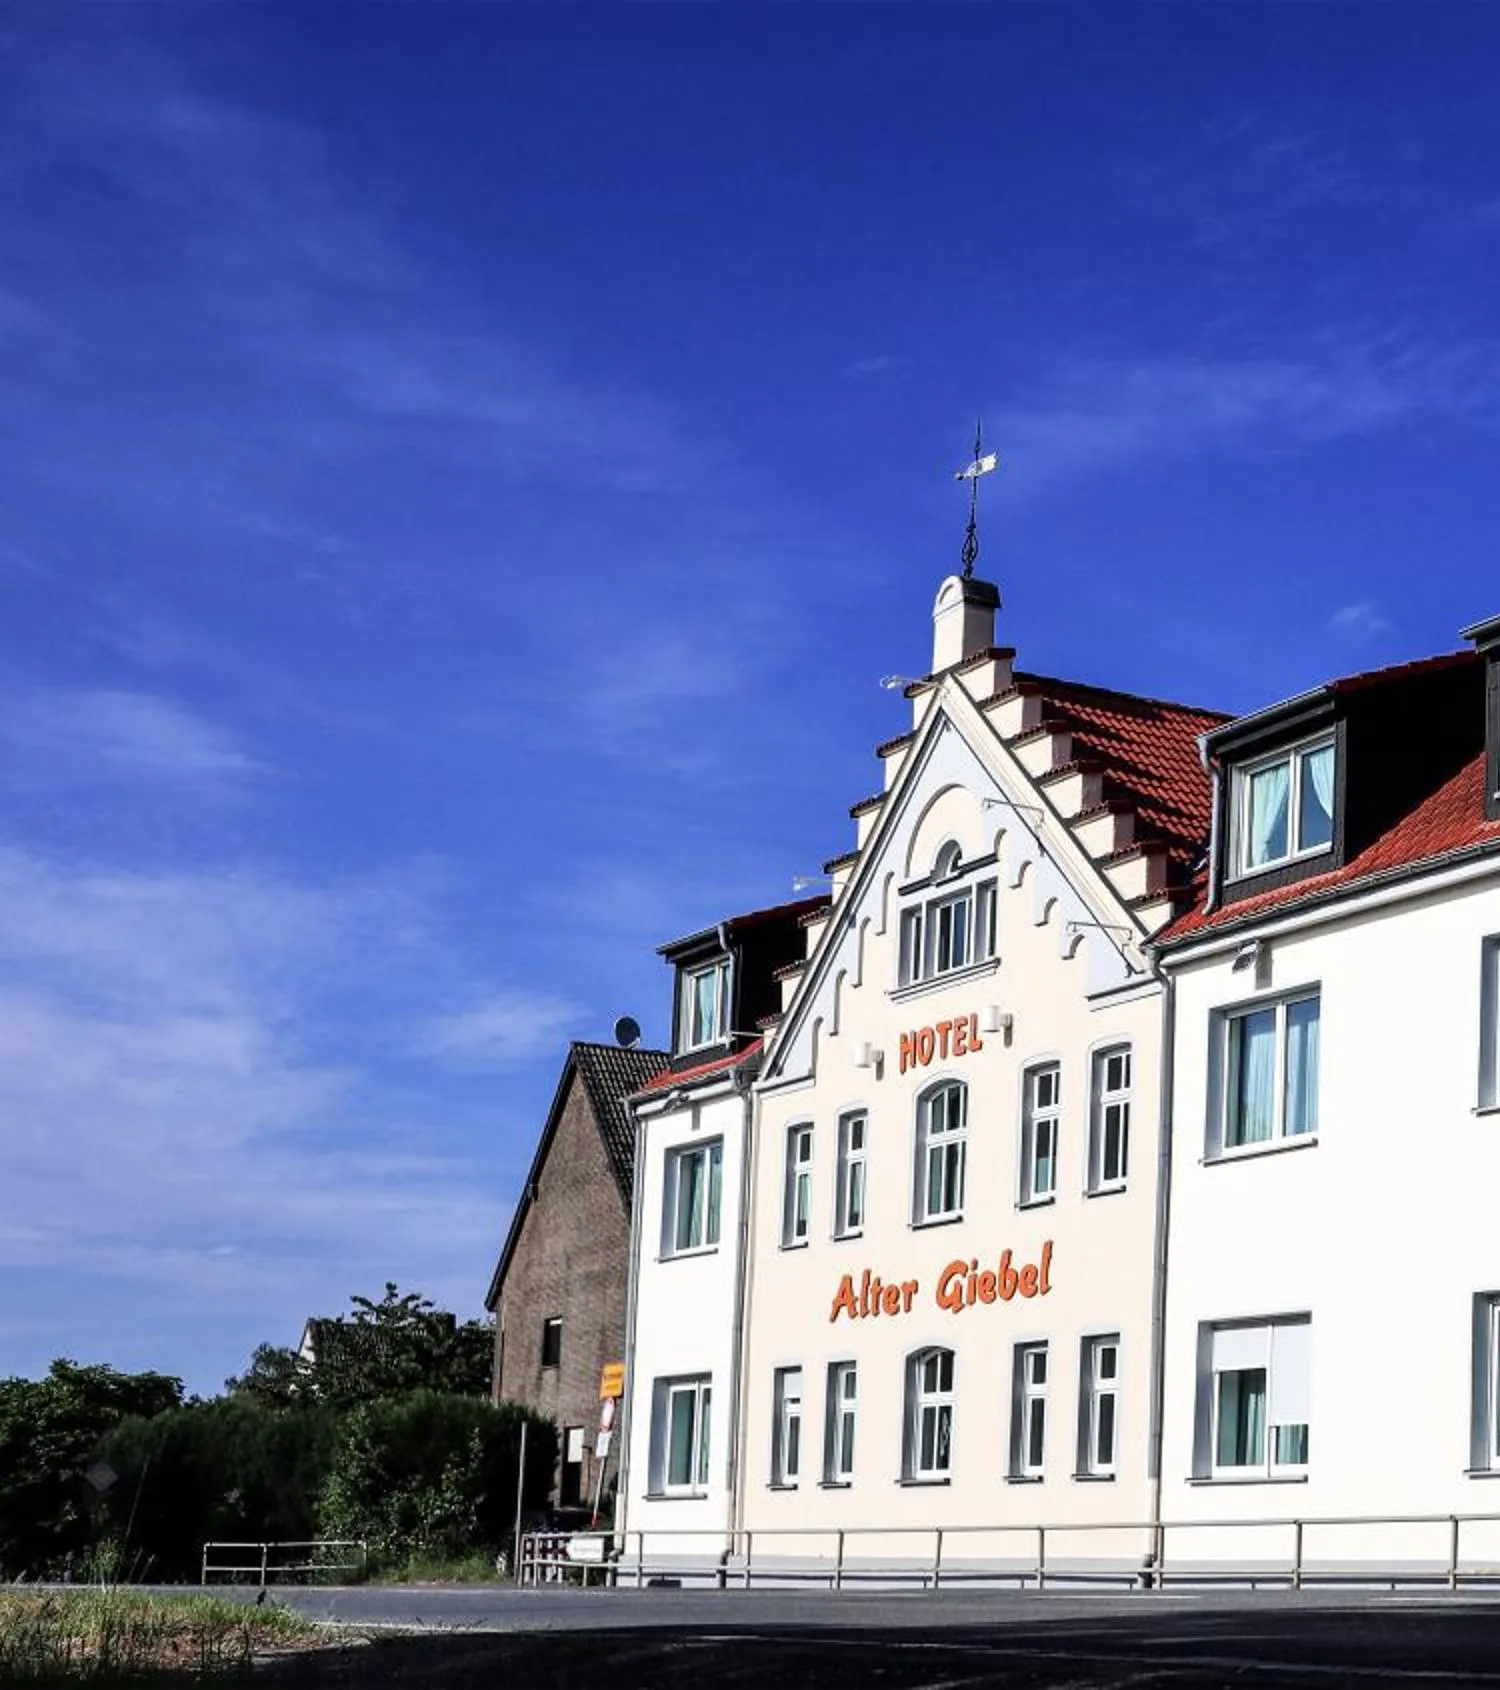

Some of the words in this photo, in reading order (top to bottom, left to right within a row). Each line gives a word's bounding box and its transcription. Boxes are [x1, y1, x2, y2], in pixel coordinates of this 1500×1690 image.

[899, 1013, 983, 1074] HOTEL
[829, 1268, 918, 1323] Alter
[935, 1239, 1055, 1314] Giebel
